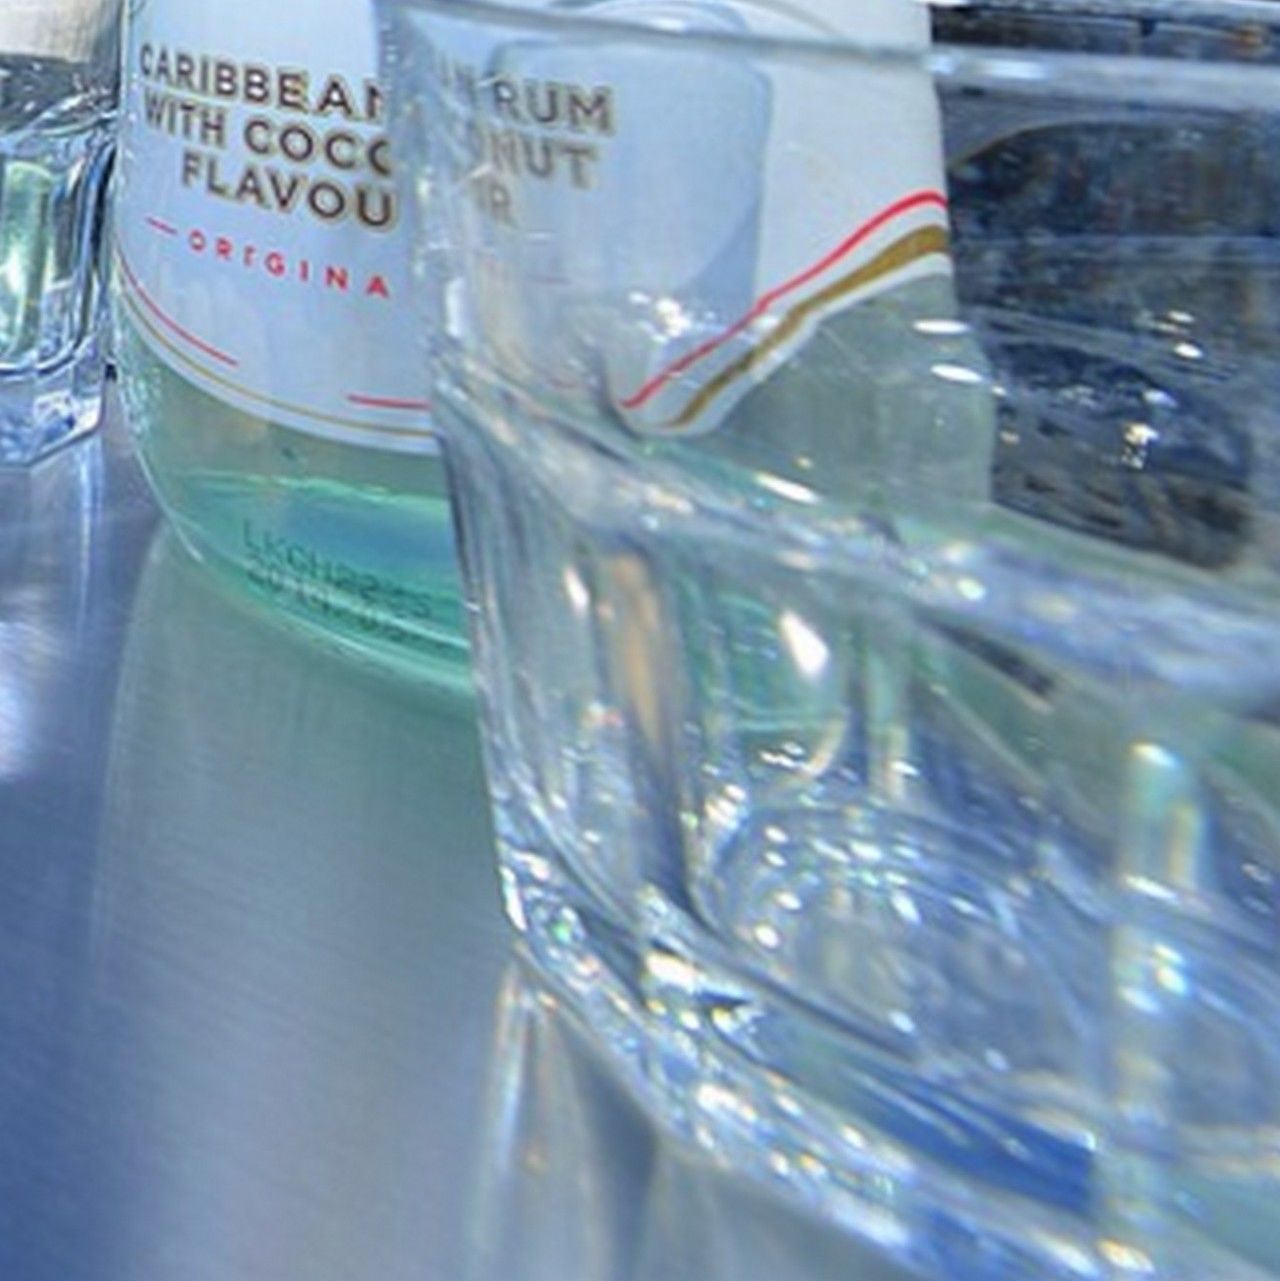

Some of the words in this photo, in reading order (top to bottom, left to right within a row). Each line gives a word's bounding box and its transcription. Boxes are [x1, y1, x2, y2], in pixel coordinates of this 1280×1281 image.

[142, 90, 228, 149] WITH
[492, 74, 616, 136] RUM
[188, 229, 392, 299] ORIGINA
